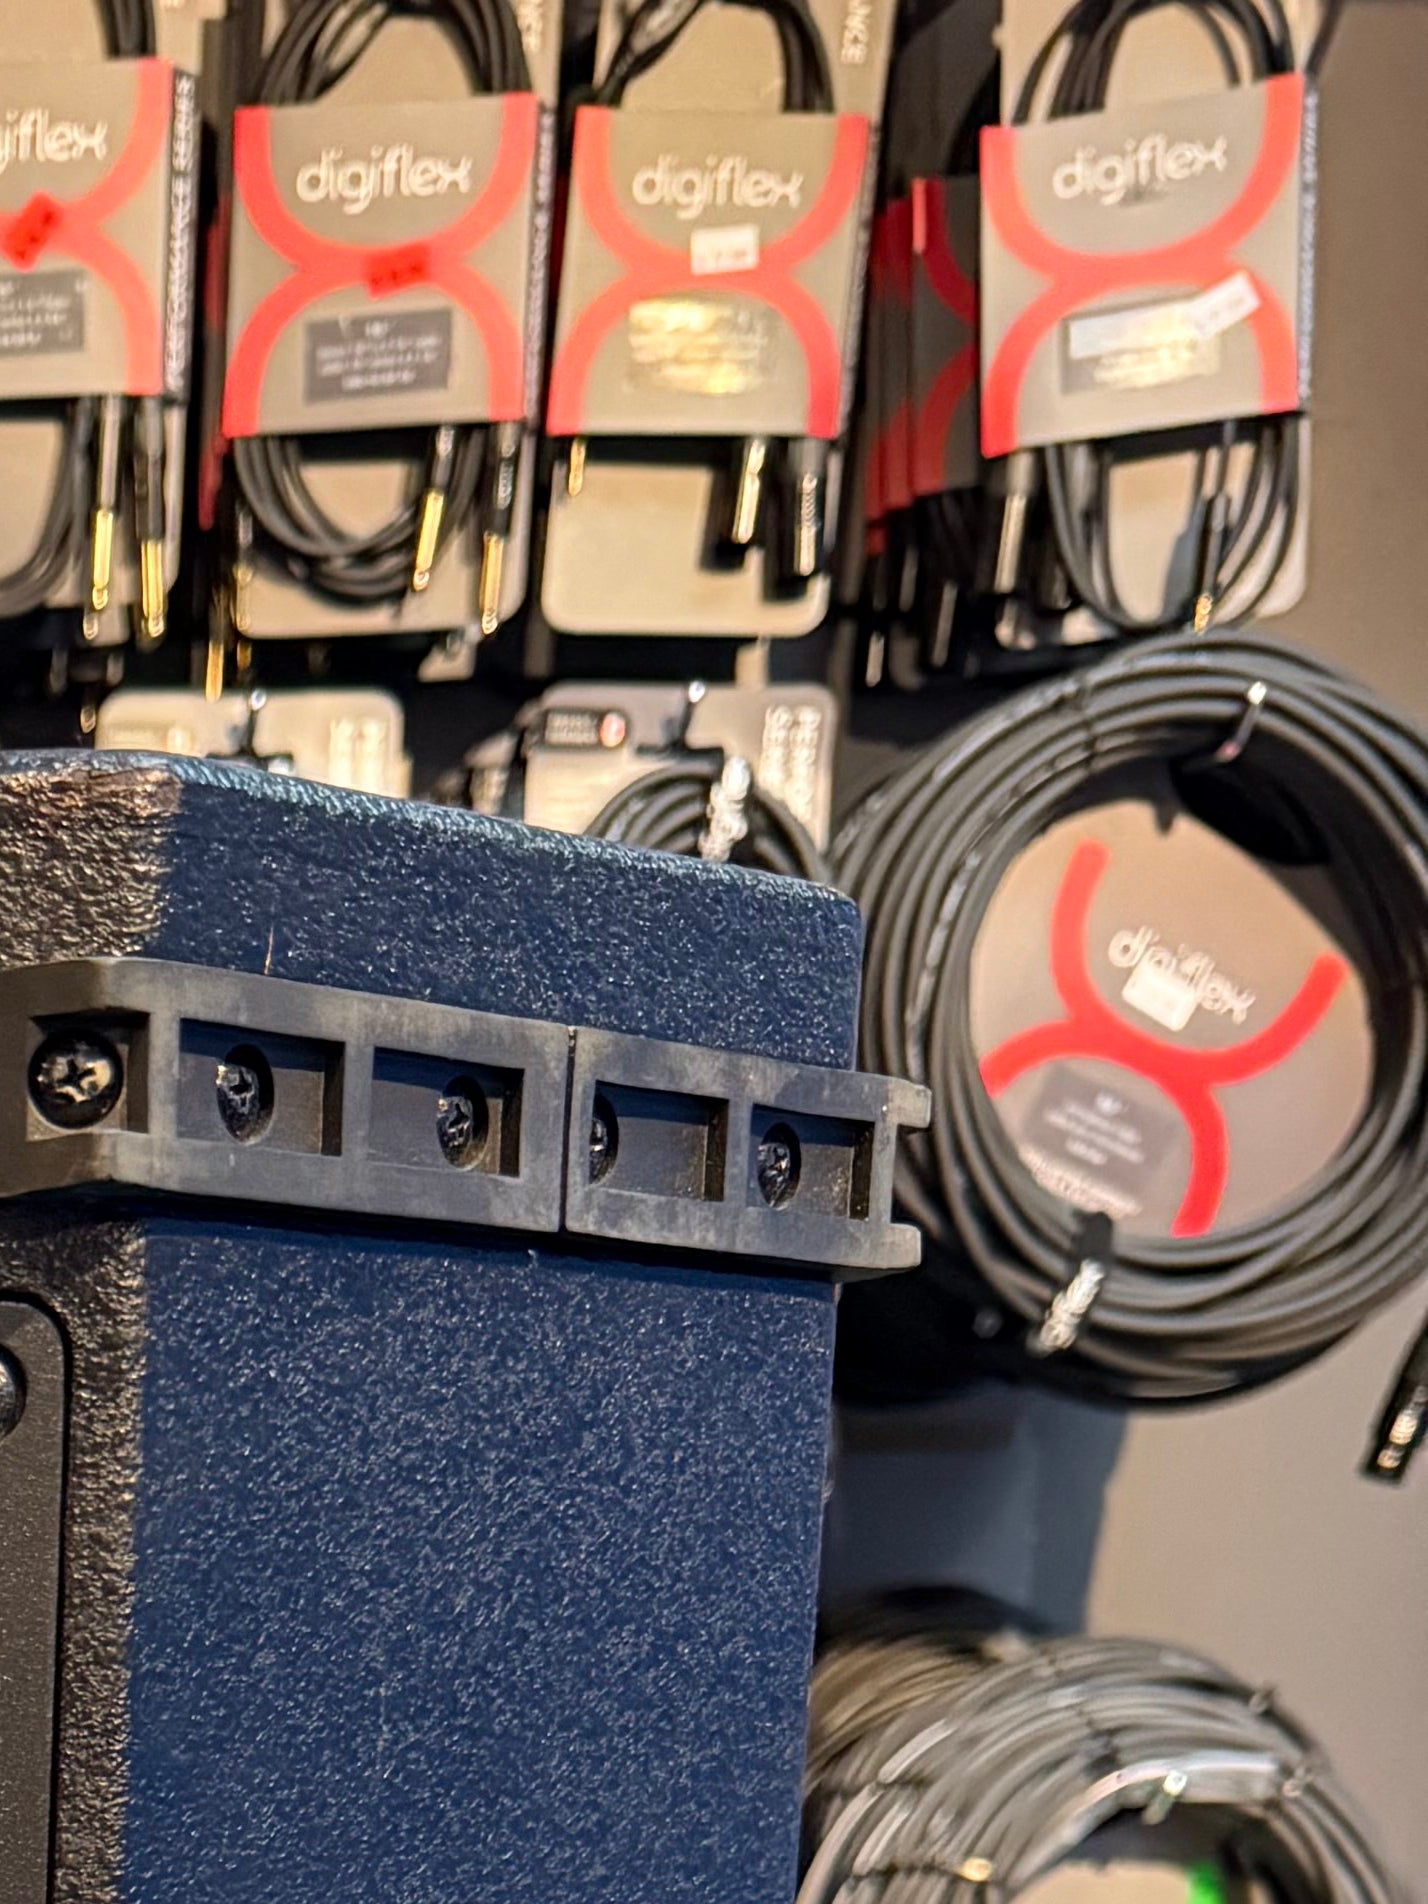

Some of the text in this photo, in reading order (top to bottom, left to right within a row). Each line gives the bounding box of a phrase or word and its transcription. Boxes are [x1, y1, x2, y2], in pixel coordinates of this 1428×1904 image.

[296, 143, 473, 215] digiflex
[632, 154, 803, 220] digiflex
[1052, 133, 1228, 206] digiflex
